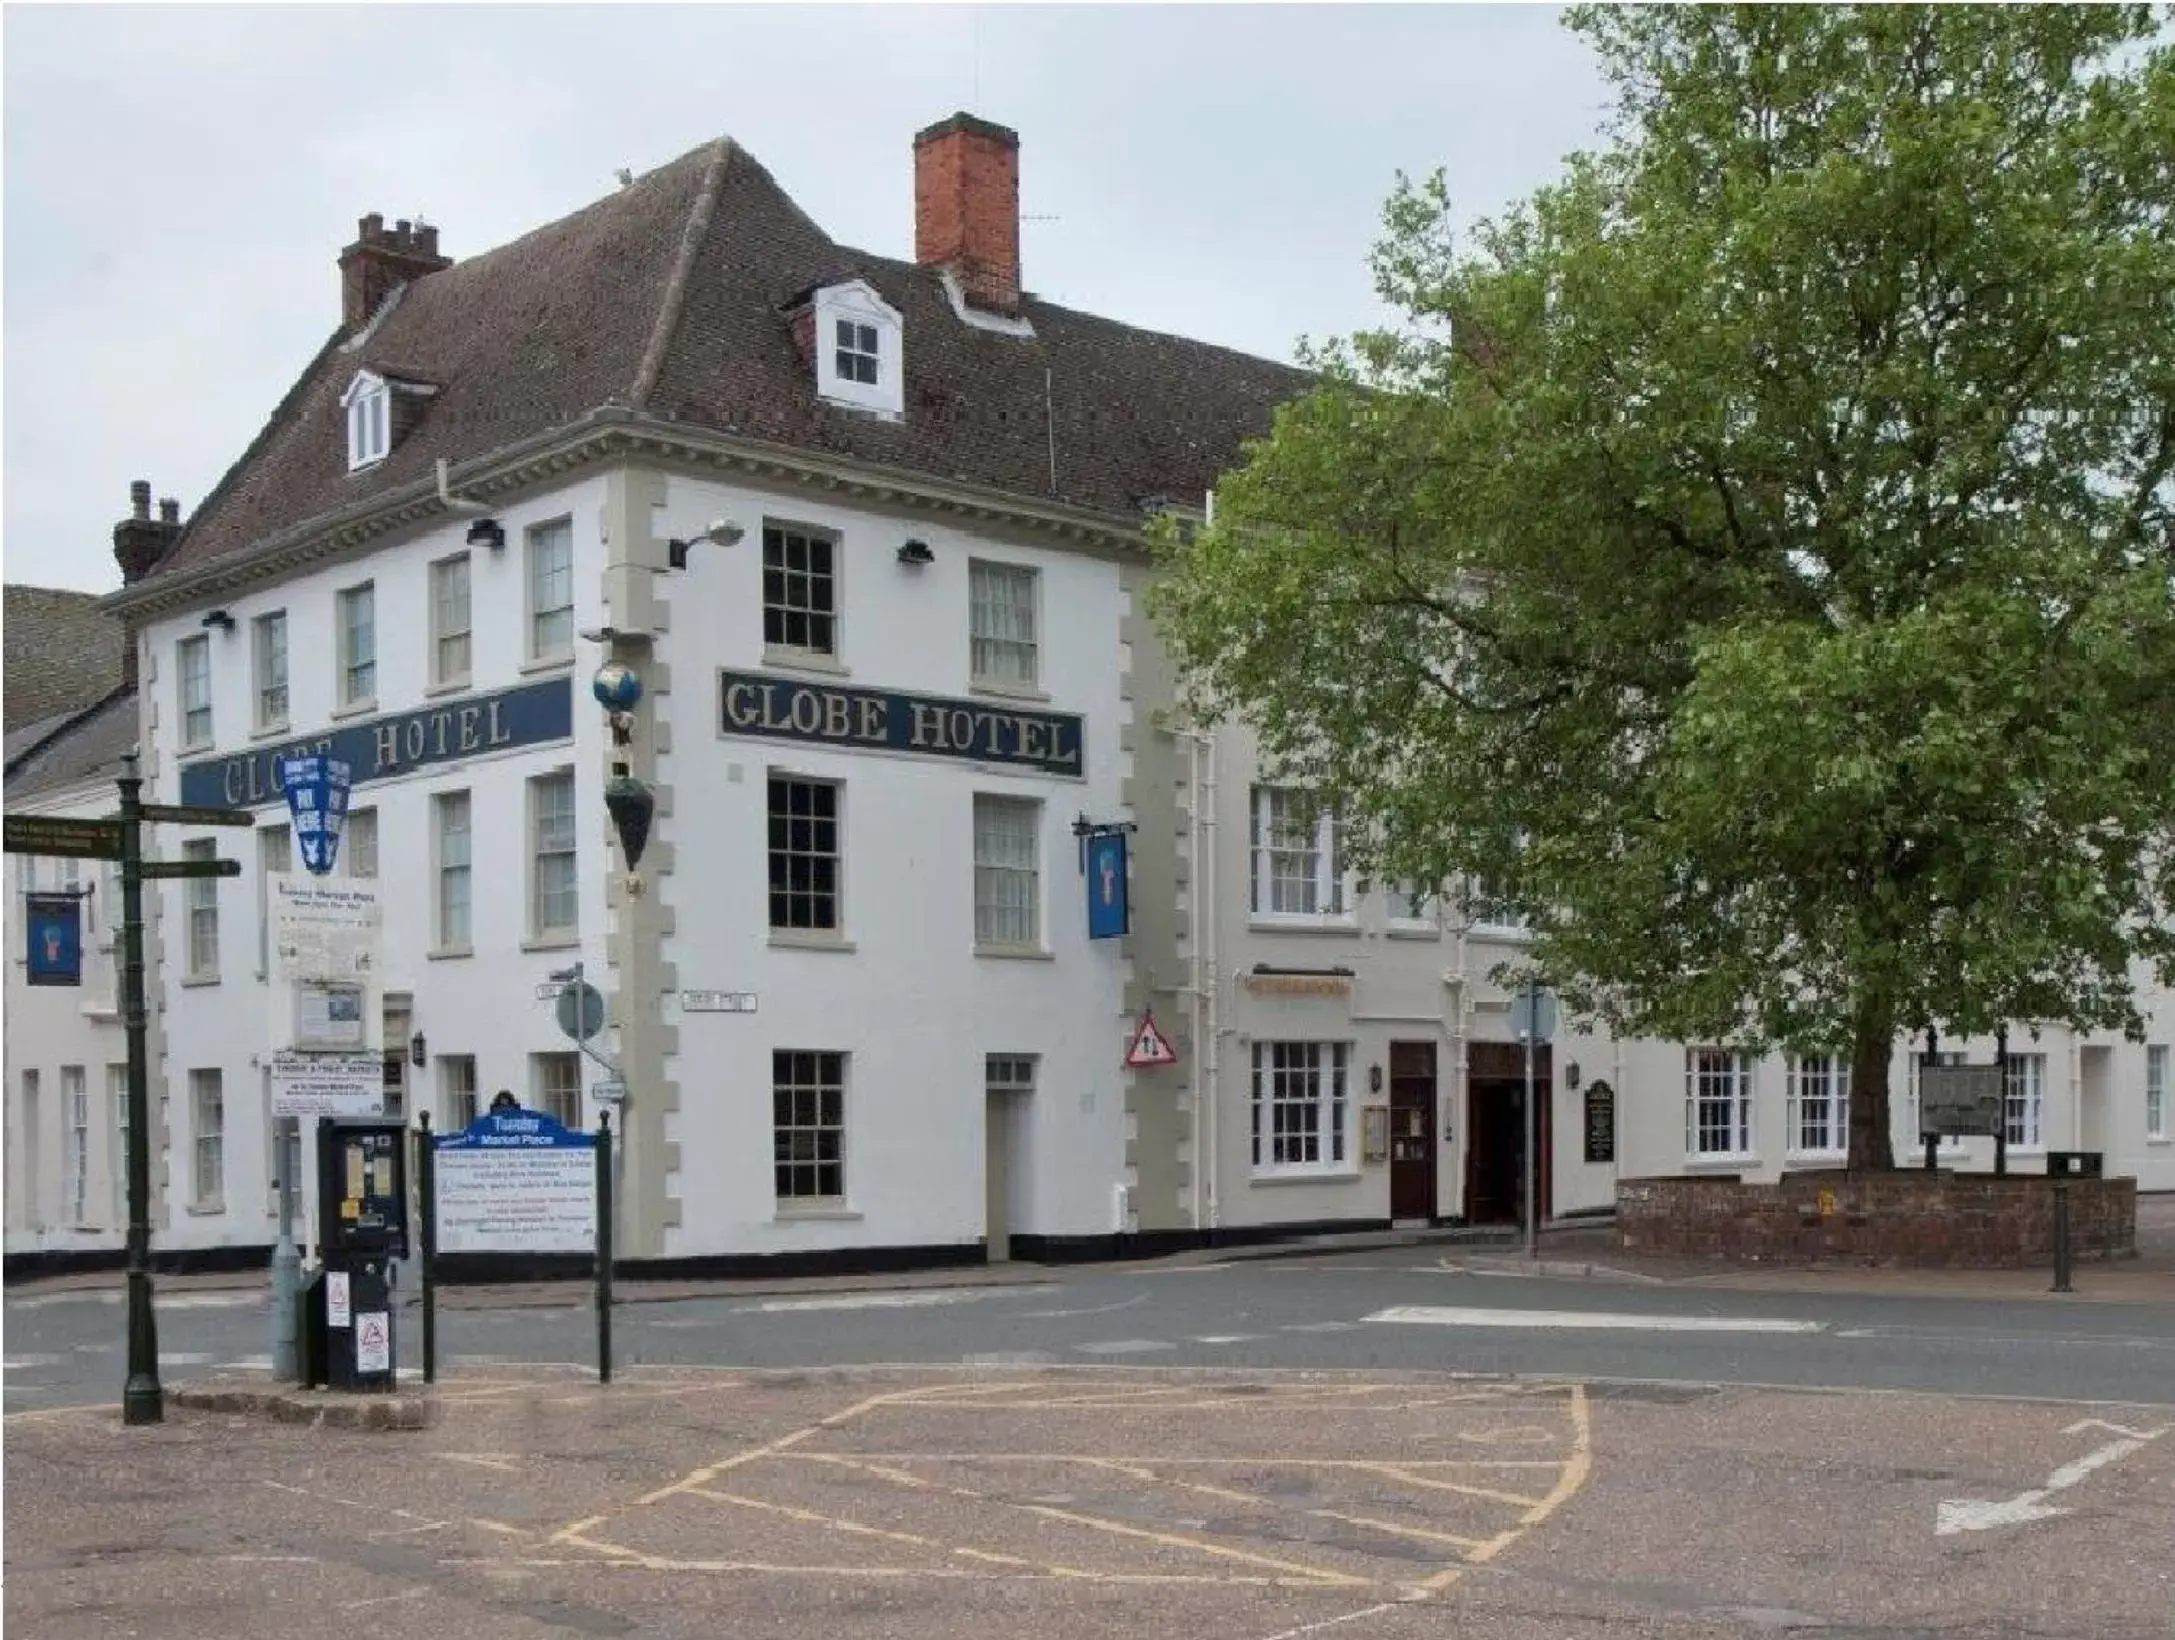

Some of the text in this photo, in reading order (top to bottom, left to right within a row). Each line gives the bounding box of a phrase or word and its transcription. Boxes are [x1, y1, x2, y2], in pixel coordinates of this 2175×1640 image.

[225, 740, 331, 804] GLO
[373, 701, 511, 771] HOTEL
[726, 683, 1077, 763] GLOBE HOTEL
